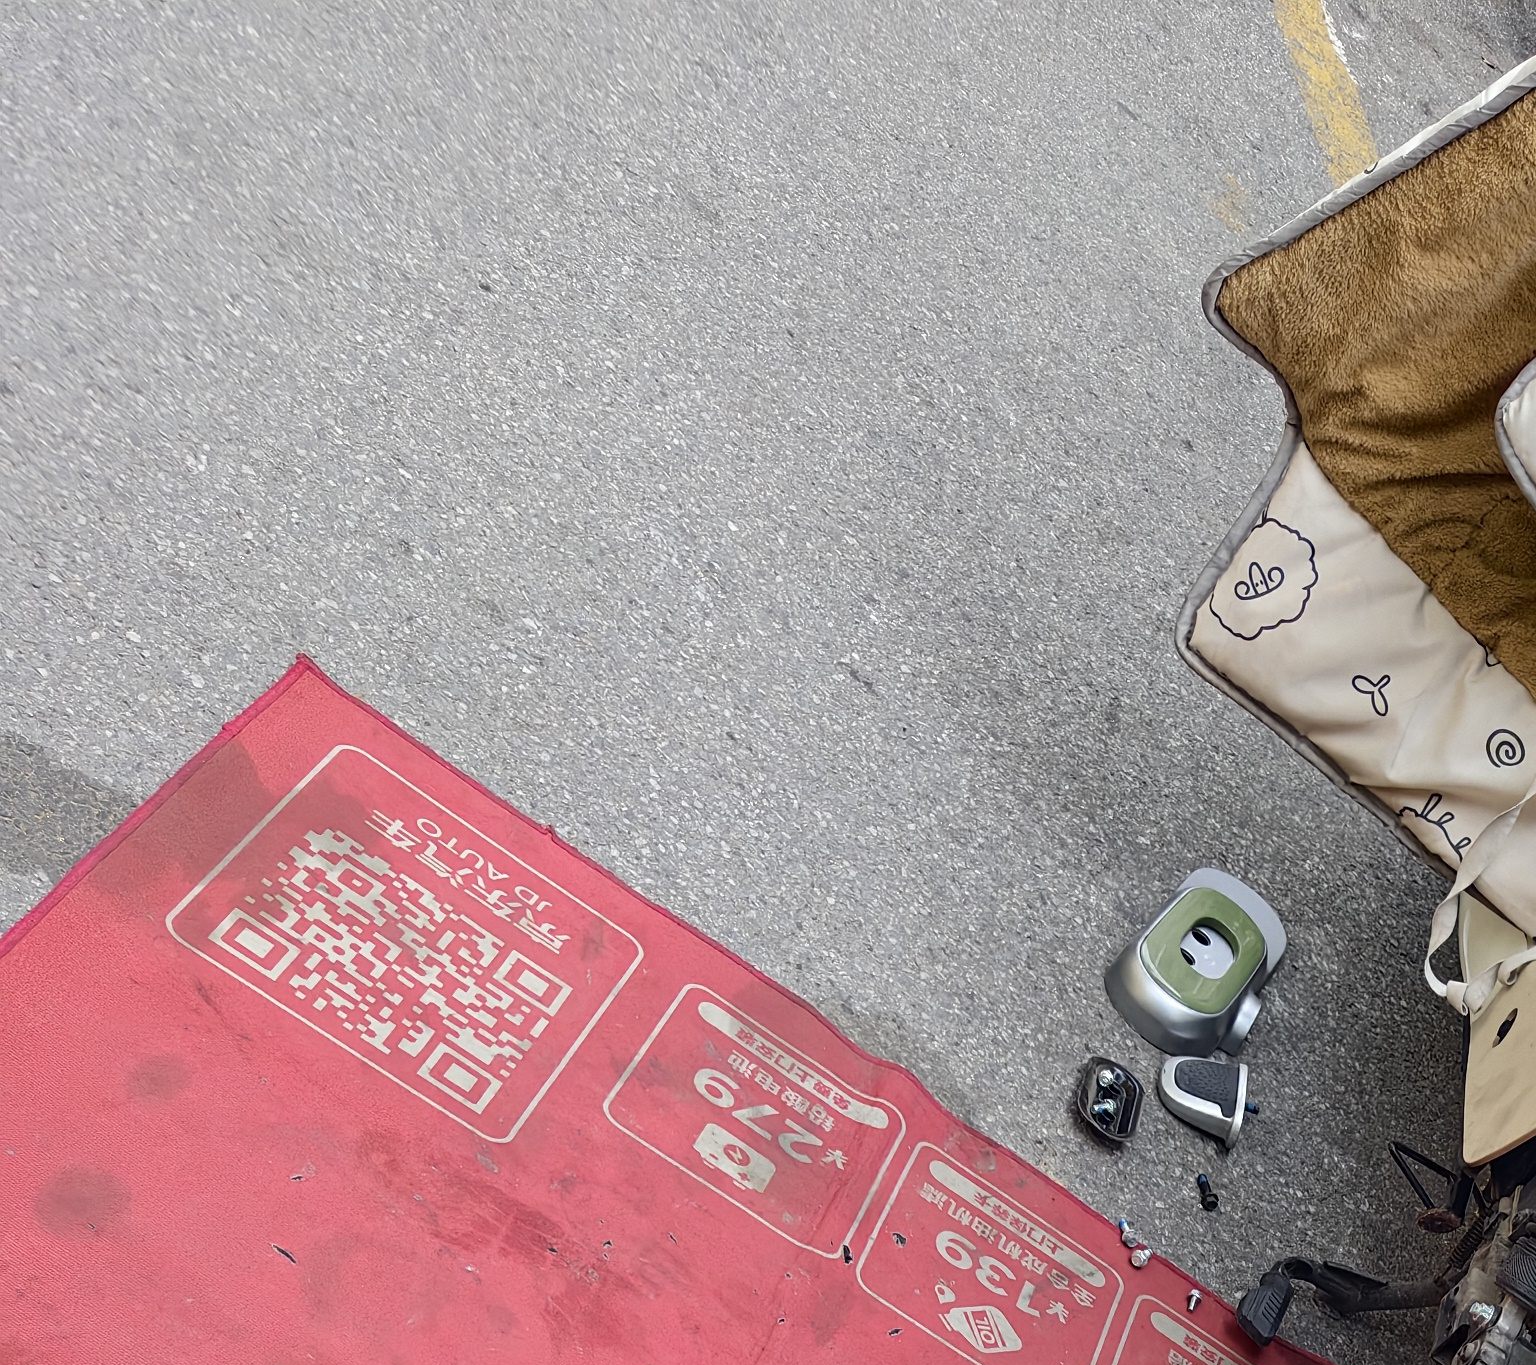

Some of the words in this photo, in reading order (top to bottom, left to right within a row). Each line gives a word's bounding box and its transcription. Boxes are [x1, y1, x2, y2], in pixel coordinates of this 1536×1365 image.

[363, 808, 571, 955] 京东汽车
[413, 813, 510, 886] AUTO
[512, 881, 552, 914] JD
[724, 1048, 839, 1132] 铅酸电池
[732, 1025, 852, 1111] 免费上门安装
[690, 1066, 847, 1170] ¥279
[916, 1180, 1098, 1310] 全合成机油机滤
[970, 1188, 1063, 1257] 上门保养卡
[932, 1229, 1072, 1323] ¥139
[976, 1313, 996, 1346] OIL
